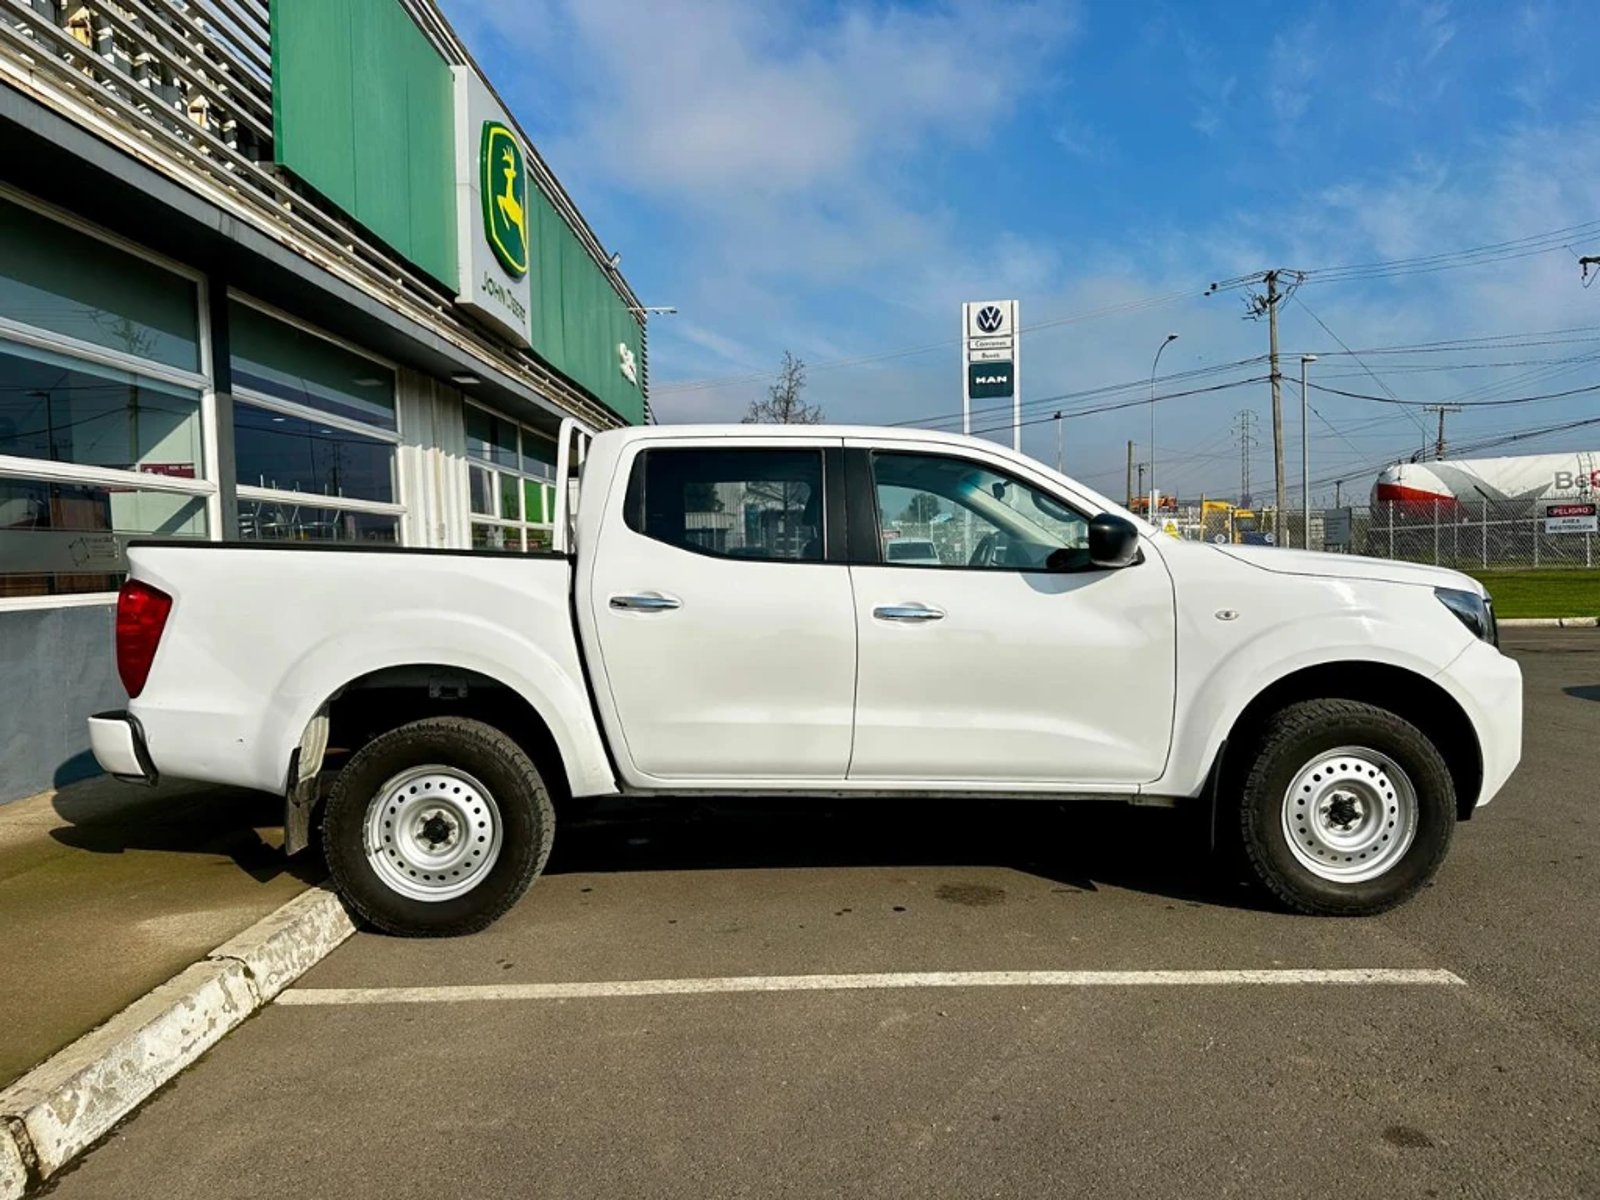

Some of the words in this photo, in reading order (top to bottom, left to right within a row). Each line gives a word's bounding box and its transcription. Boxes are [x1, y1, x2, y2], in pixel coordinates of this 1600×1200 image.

[481, 271, 505, 305] JOHN
[506, 288, 526, 326] DEERE
[975, 376, 1007, 384] MAN
[1552, 507, 1589, 515] PELIGRO
